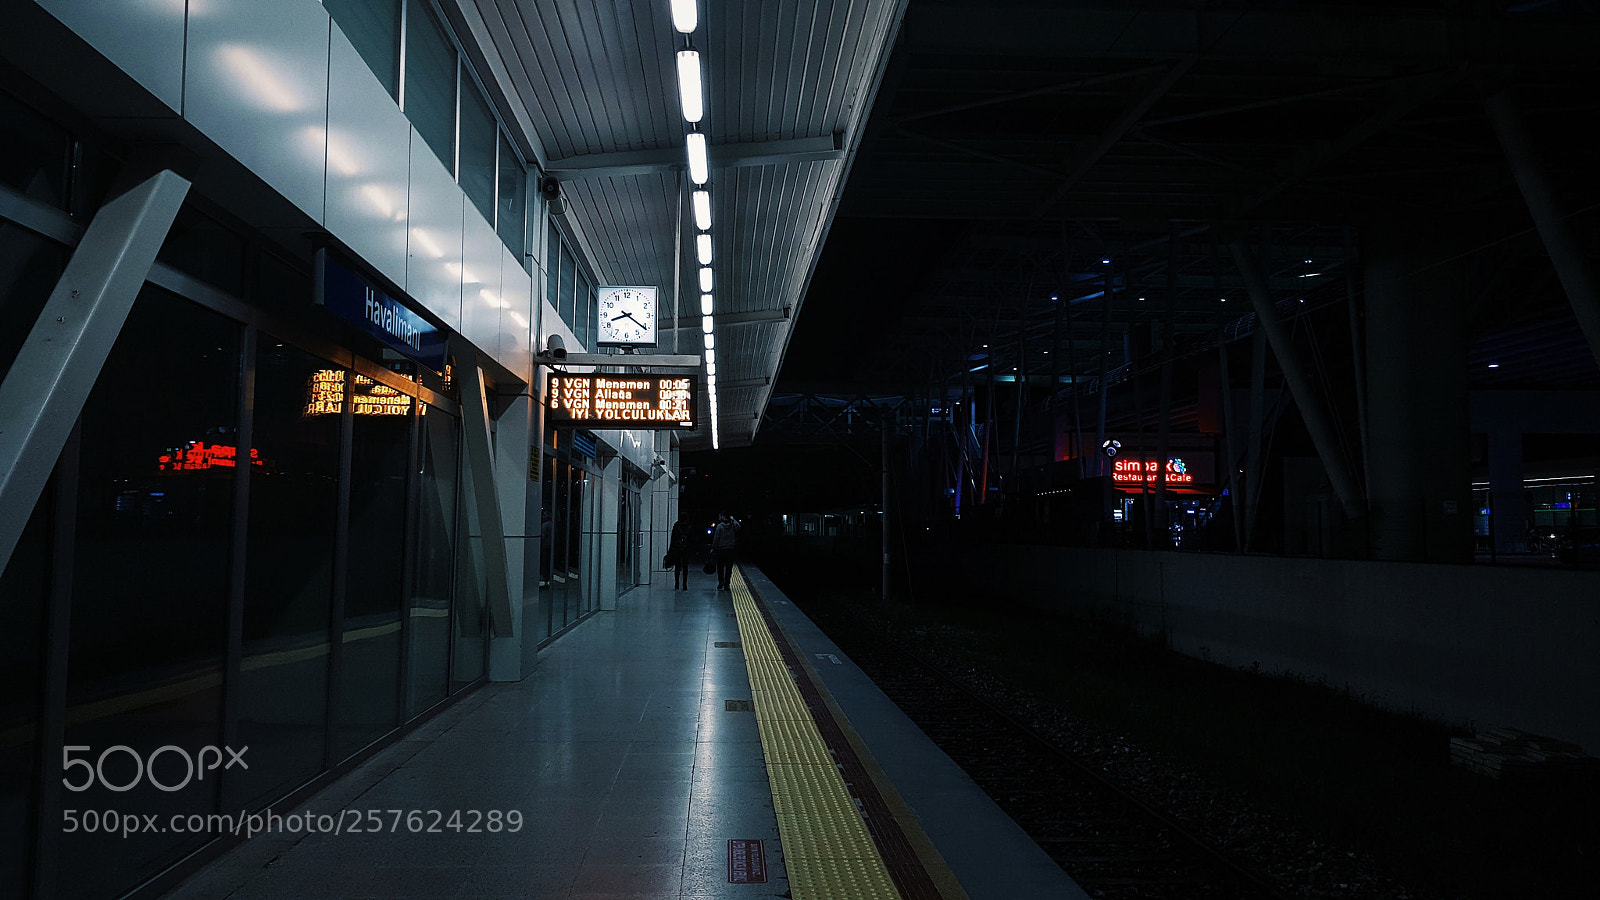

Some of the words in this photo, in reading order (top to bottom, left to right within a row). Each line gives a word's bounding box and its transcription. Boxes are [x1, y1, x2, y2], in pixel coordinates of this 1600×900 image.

[551, 378, 559, 389] 9
[564, 378, 591, 389] VGN
[596, 378, 650, 389] Menemen
[551, 388, 559, 399] 9
[564, 389, 590, 399] VGN
[551, 398, 559, 409] 6
[564, 399, 590, 409] VGN
[595, 399, 650, 410] Menemen
[659, 399, 688, 410] 00:21
[595, 409, 691, 421] YOLCULUKLAR
